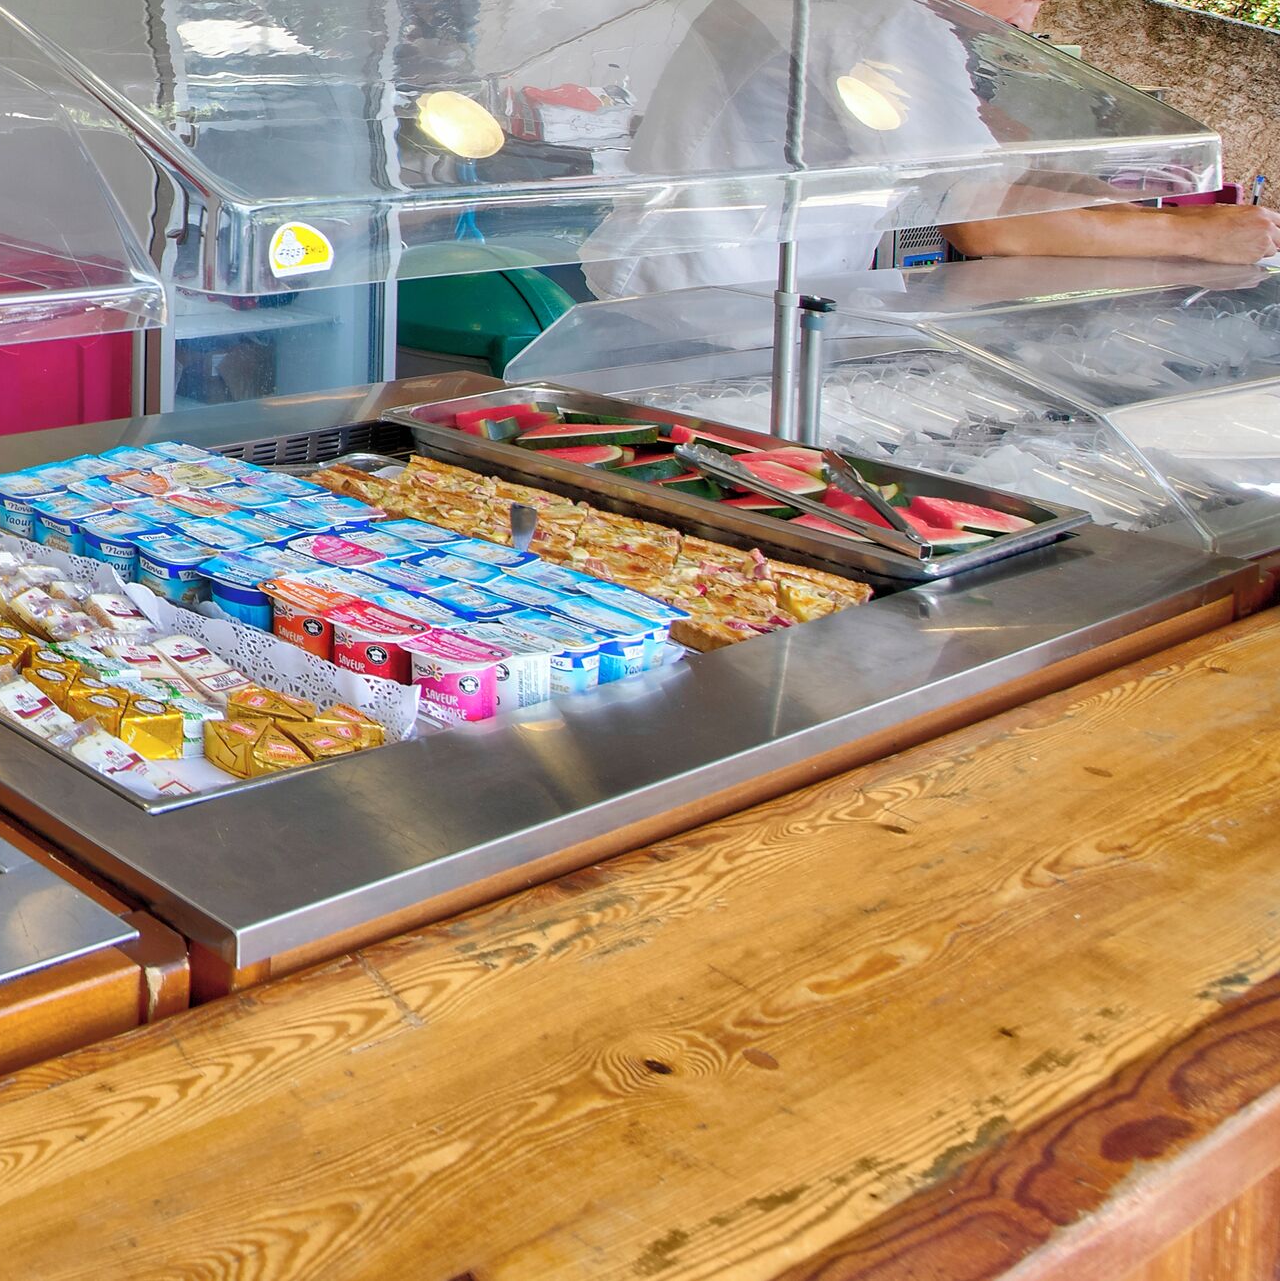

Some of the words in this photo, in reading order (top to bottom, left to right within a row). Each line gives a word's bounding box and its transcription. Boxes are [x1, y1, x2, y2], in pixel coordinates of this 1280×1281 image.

[278, 625, 305, 645] SAVEUR
[339, 653, 366, 673] SAVEUR
[425, 687, 459, 707] SAVEUR
